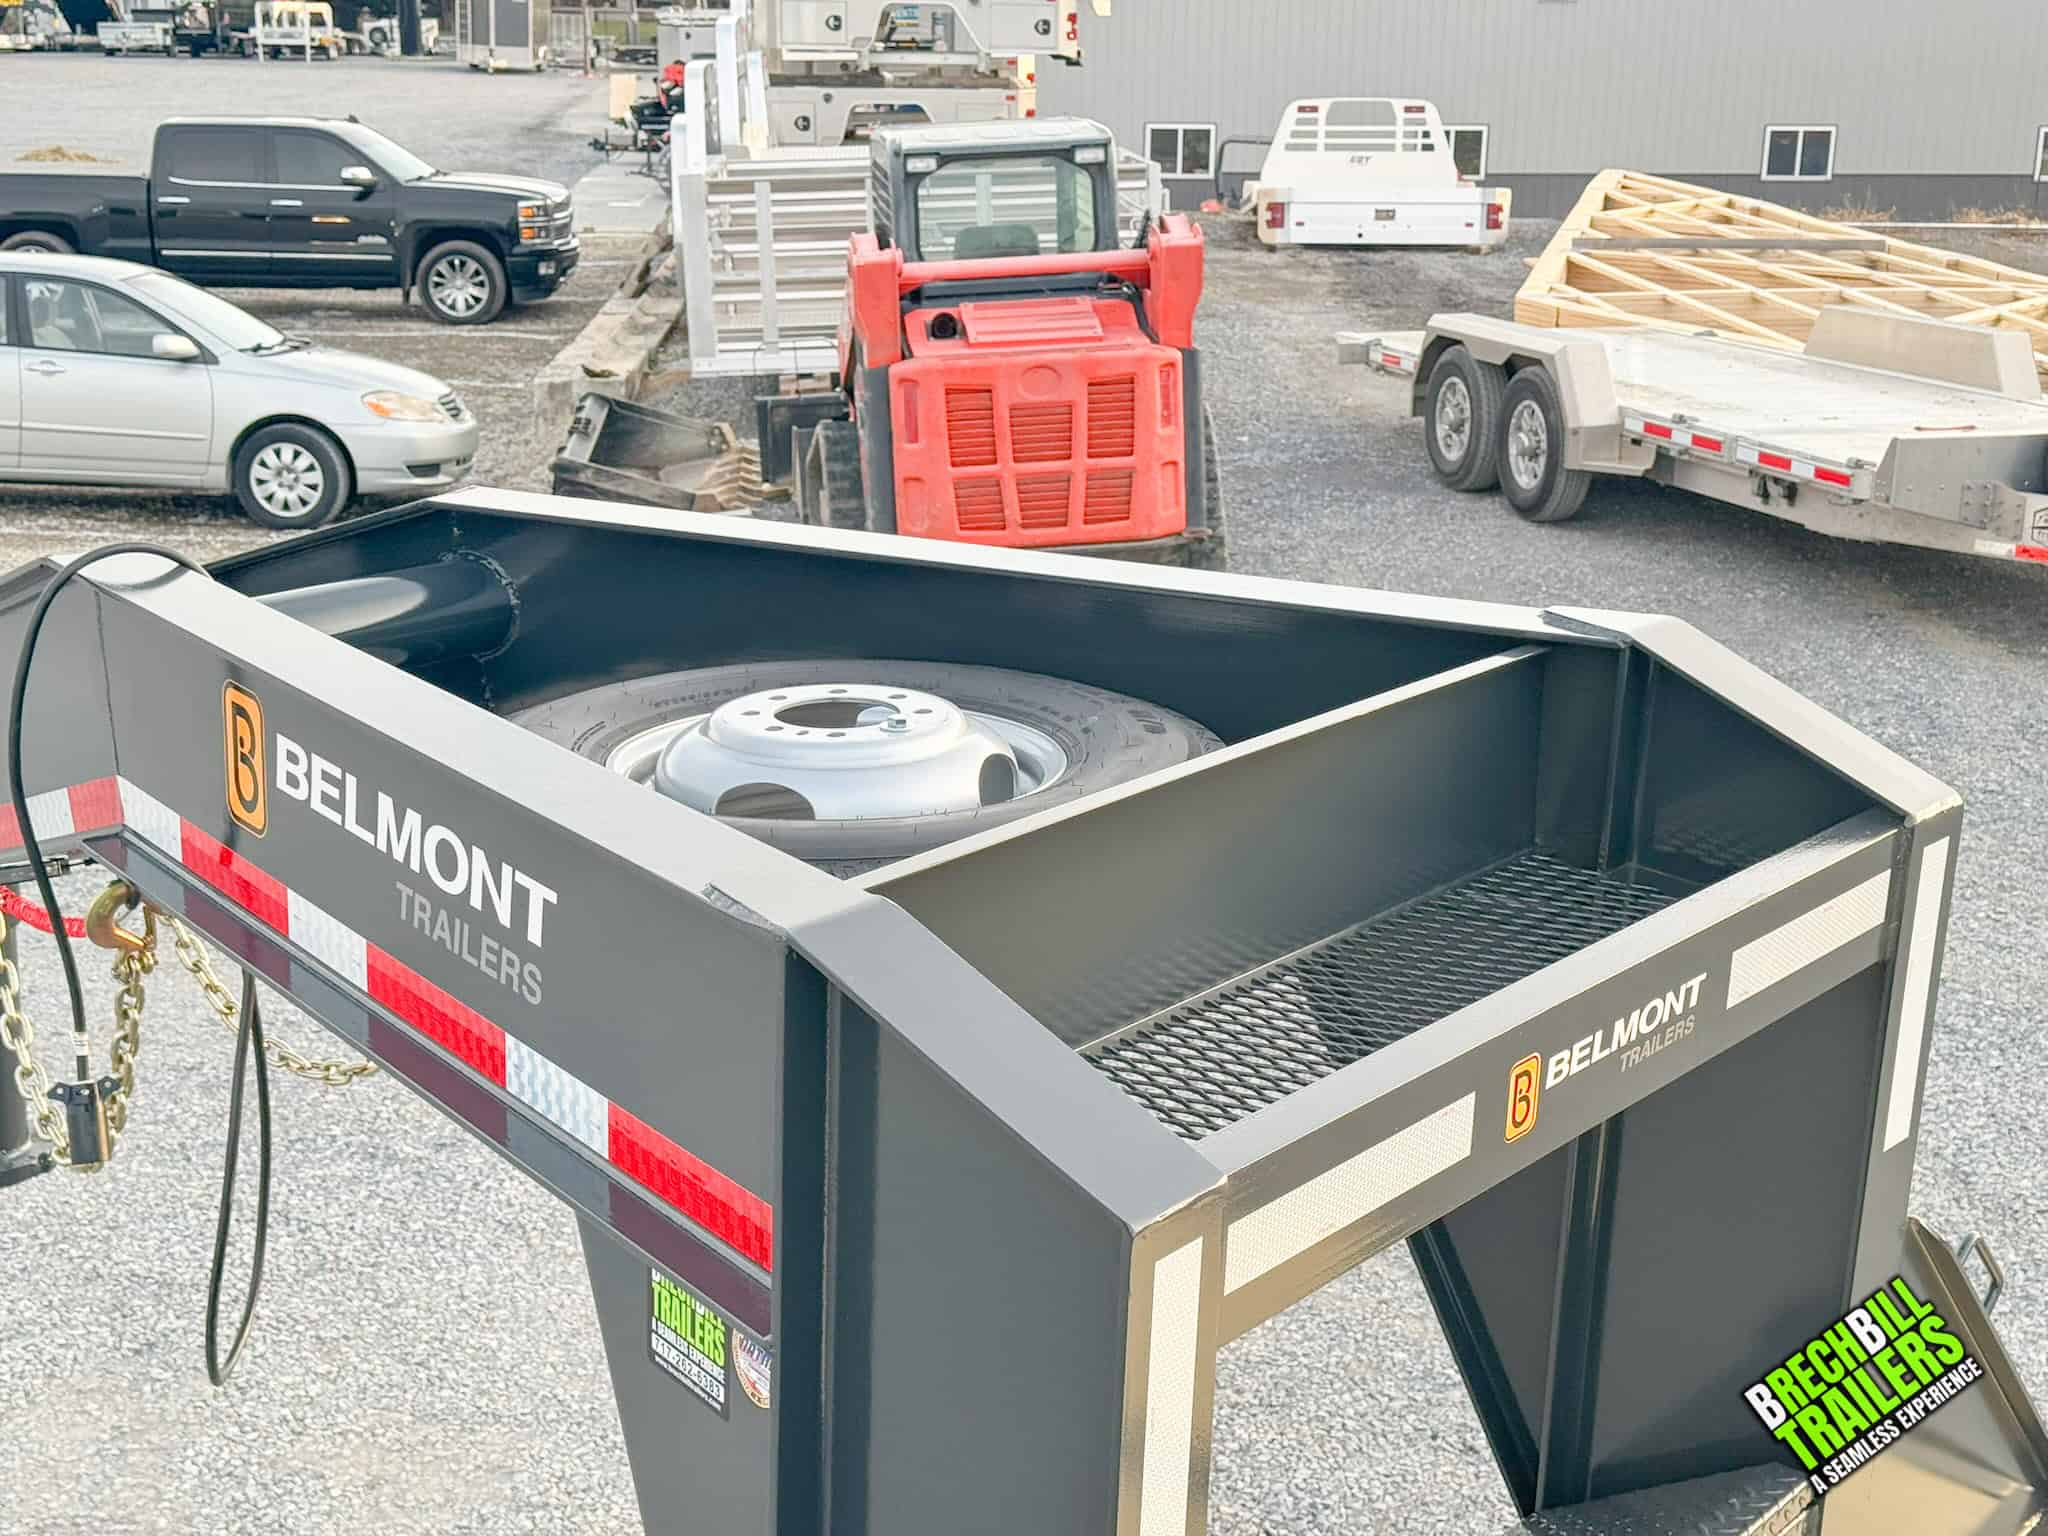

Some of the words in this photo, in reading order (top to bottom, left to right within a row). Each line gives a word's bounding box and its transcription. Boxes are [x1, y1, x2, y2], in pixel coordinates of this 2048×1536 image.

[276, 733, 558, 948] BELMONT
[396, 881, 543, 1006] TRAILERS
[1546, 972, 1708, 1090] BELMONT
[1619, 1014, 1695, 1073] TRAILERS
[652, 1281, 725, 1367] TRAILERS
[655, 1337, 721, 1399] 717-262-6383
